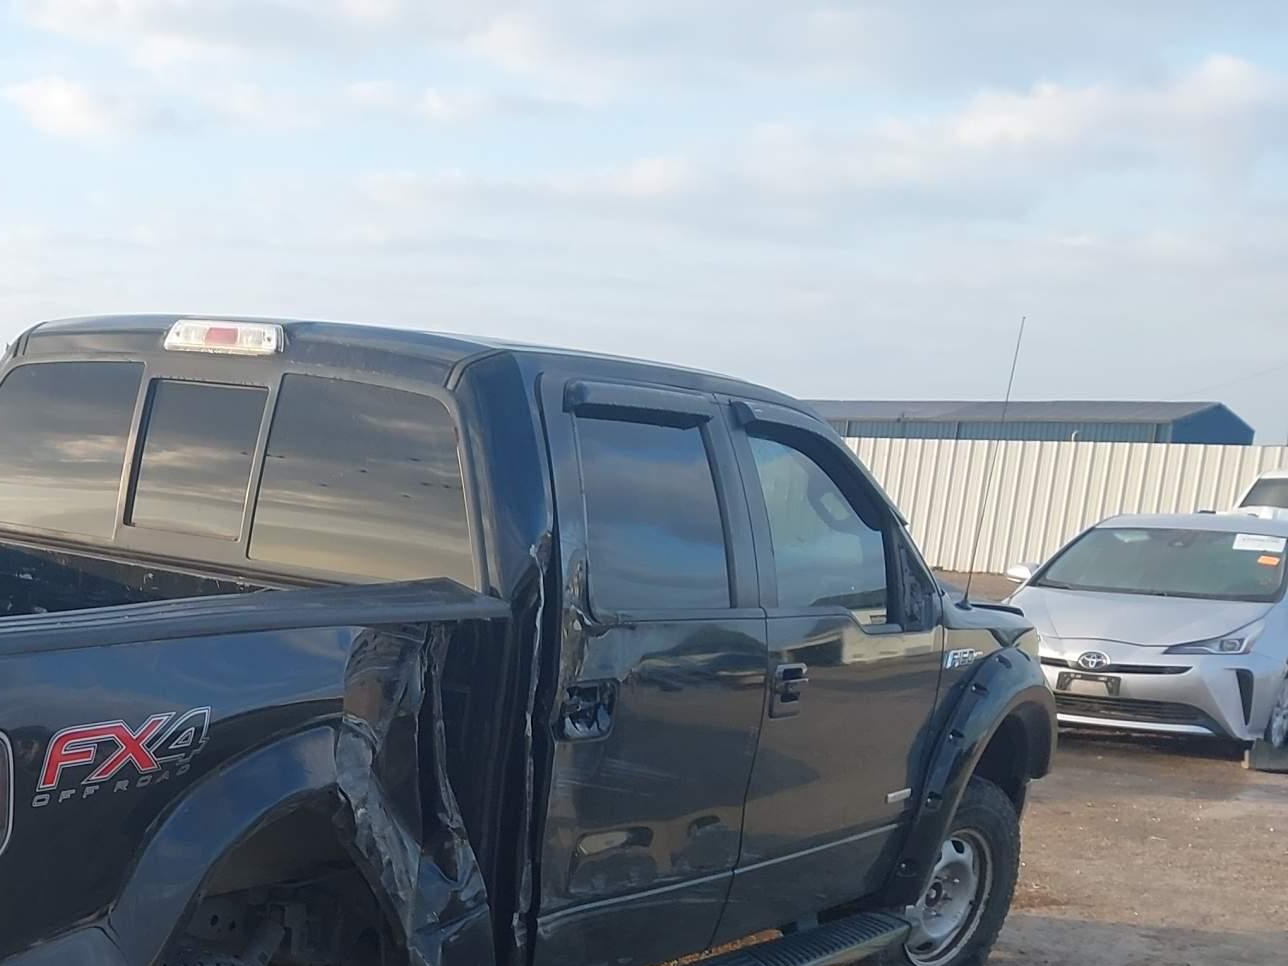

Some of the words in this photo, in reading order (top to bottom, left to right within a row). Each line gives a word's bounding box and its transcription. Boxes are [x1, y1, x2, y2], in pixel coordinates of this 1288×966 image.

[36, 706, 211, 792] FX4
[31, 785, 100, 807] OFF
[114, 763, 191, 792] ROAD
